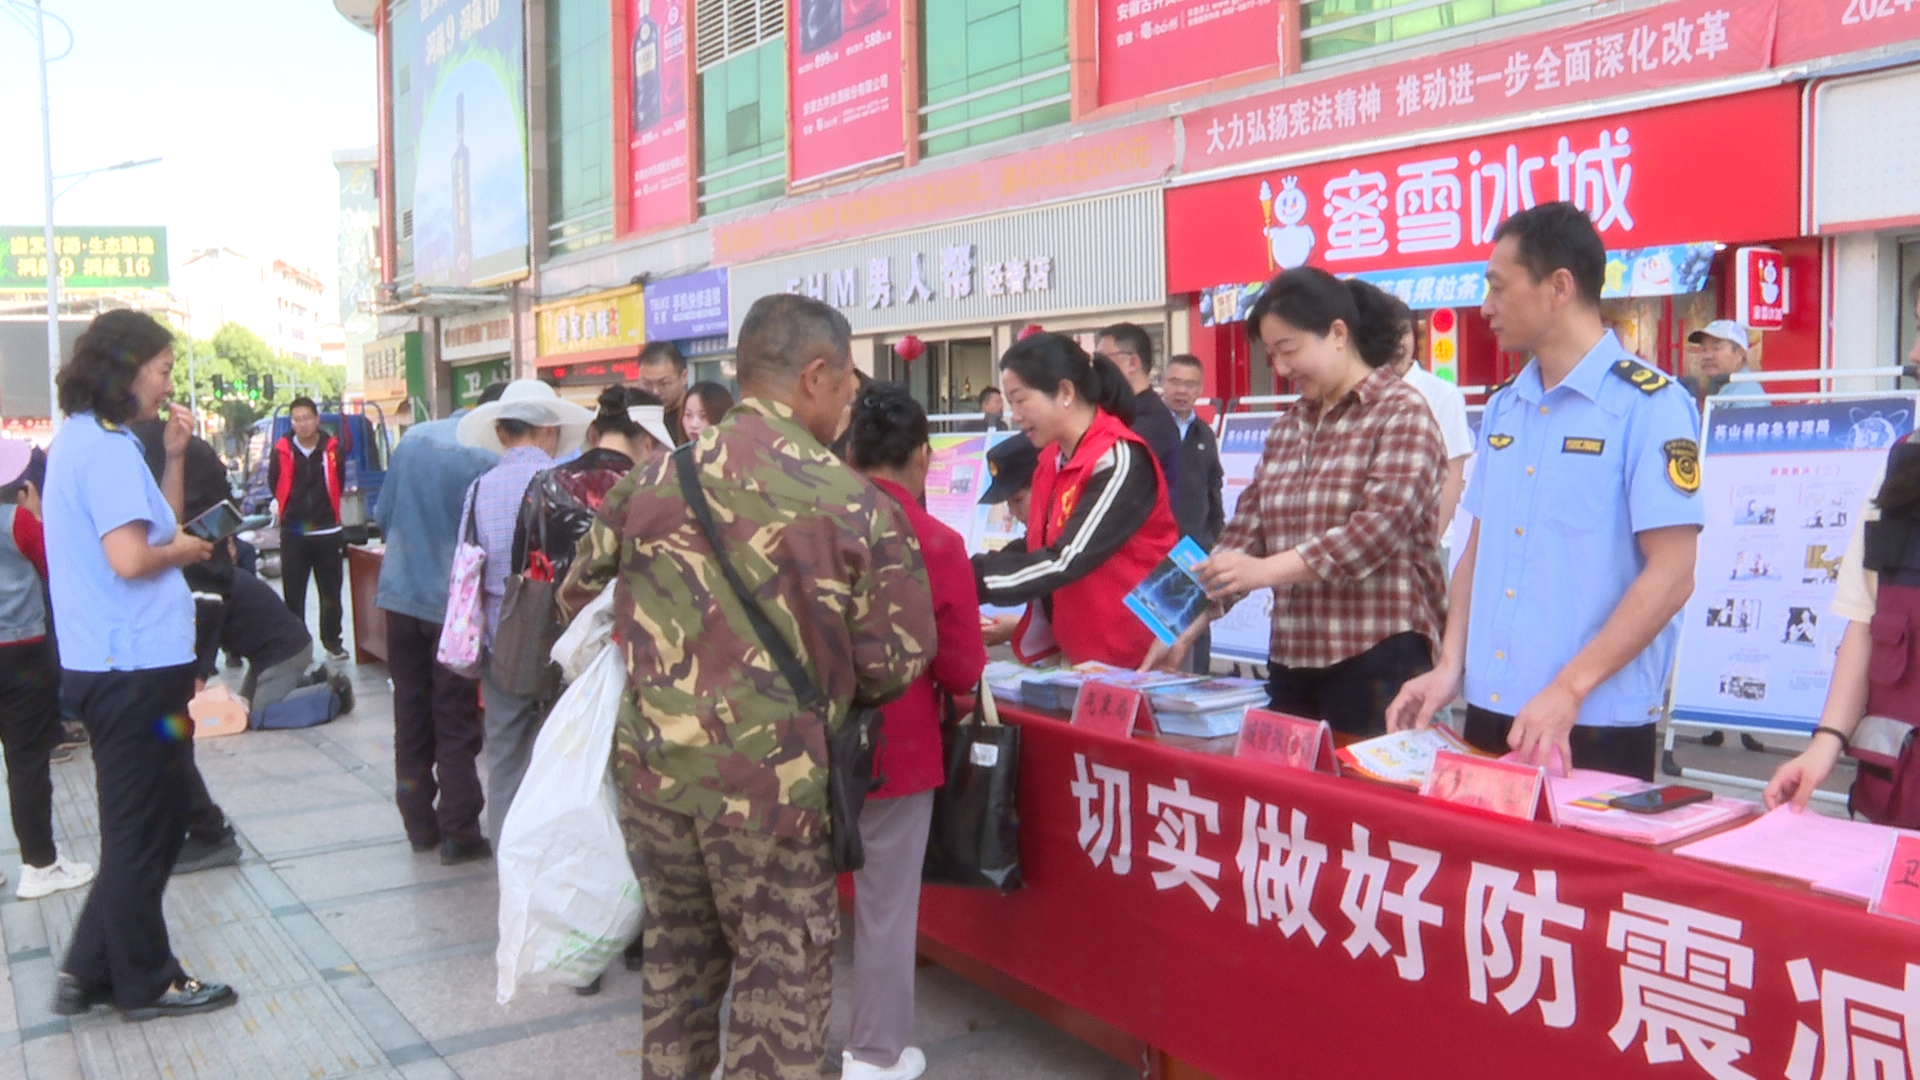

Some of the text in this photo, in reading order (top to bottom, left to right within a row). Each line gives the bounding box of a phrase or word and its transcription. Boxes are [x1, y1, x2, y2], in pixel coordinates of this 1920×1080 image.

[1396, 10, 1730, 116] 推动进一步全面深化改革
[1206, 83, 1382, 155] 大力弘扬宪法精神
[1323, 127, 1635, 261] 蜜雪冰城
[867, 244, 975, 309] 男人帮
